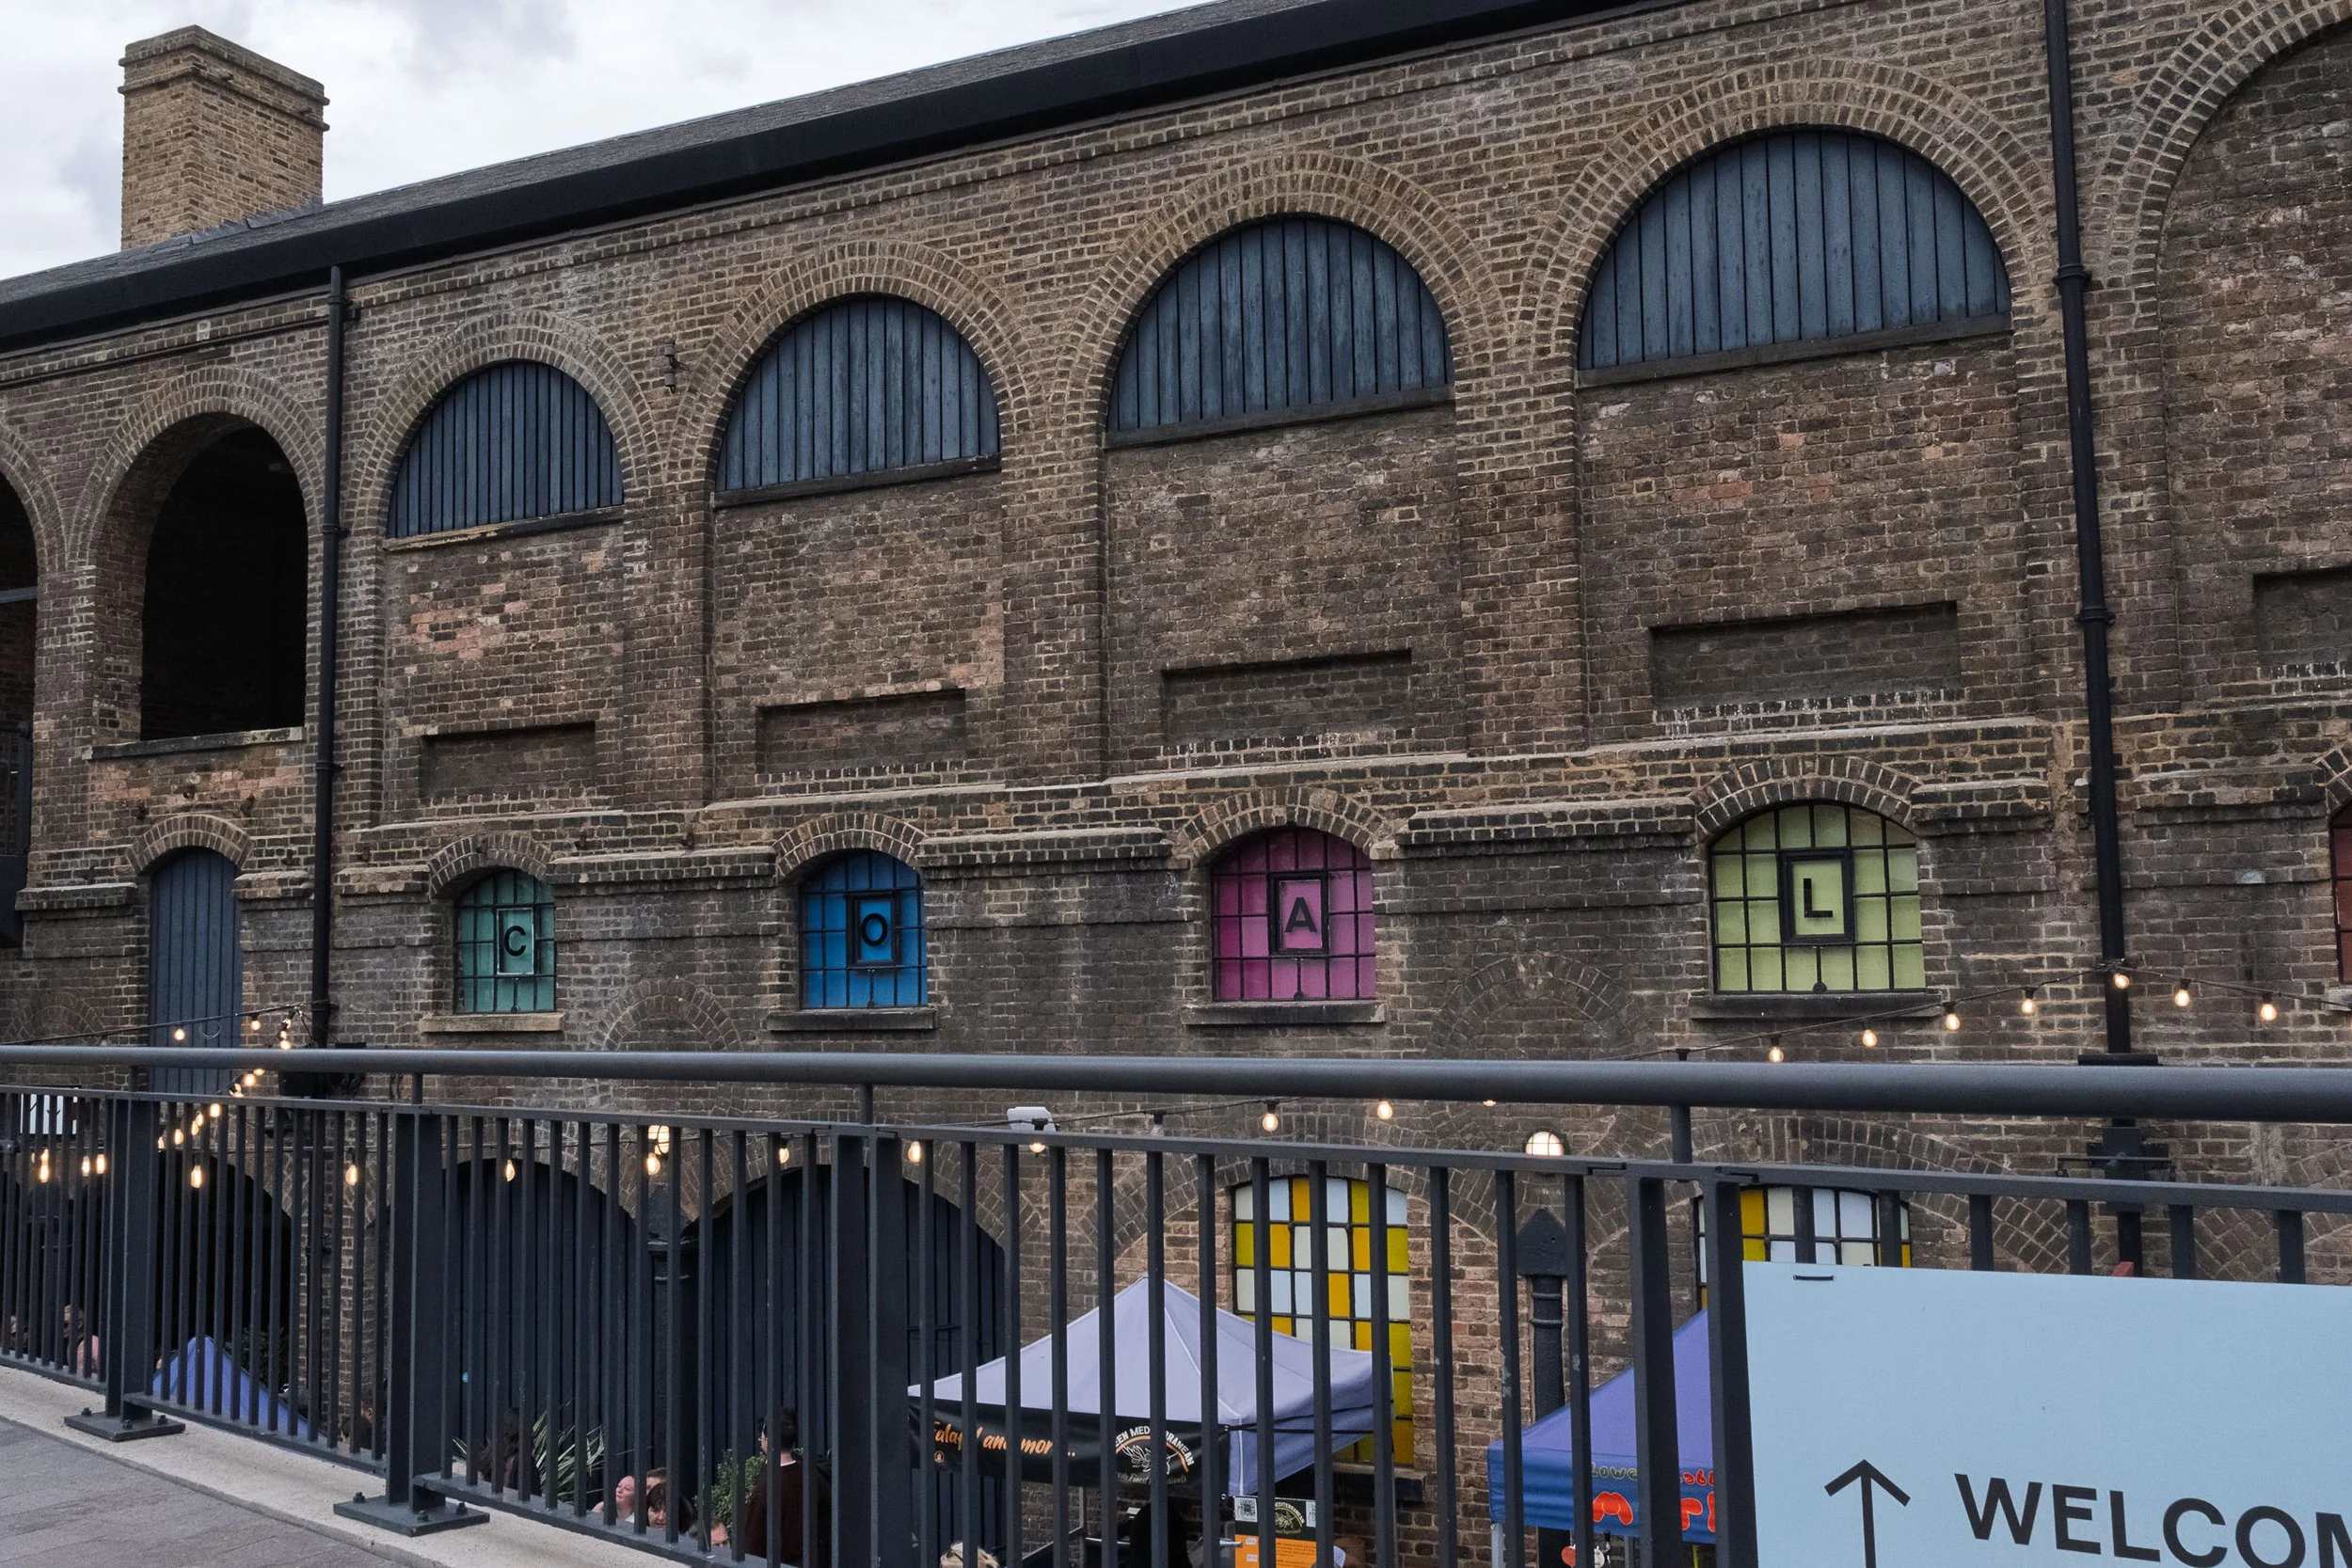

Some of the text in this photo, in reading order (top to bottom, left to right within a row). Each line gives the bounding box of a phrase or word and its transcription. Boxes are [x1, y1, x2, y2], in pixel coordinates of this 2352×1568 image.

[503, 878, 1834, 957] C O A L
[982, 1433, 1008, 1450] an
